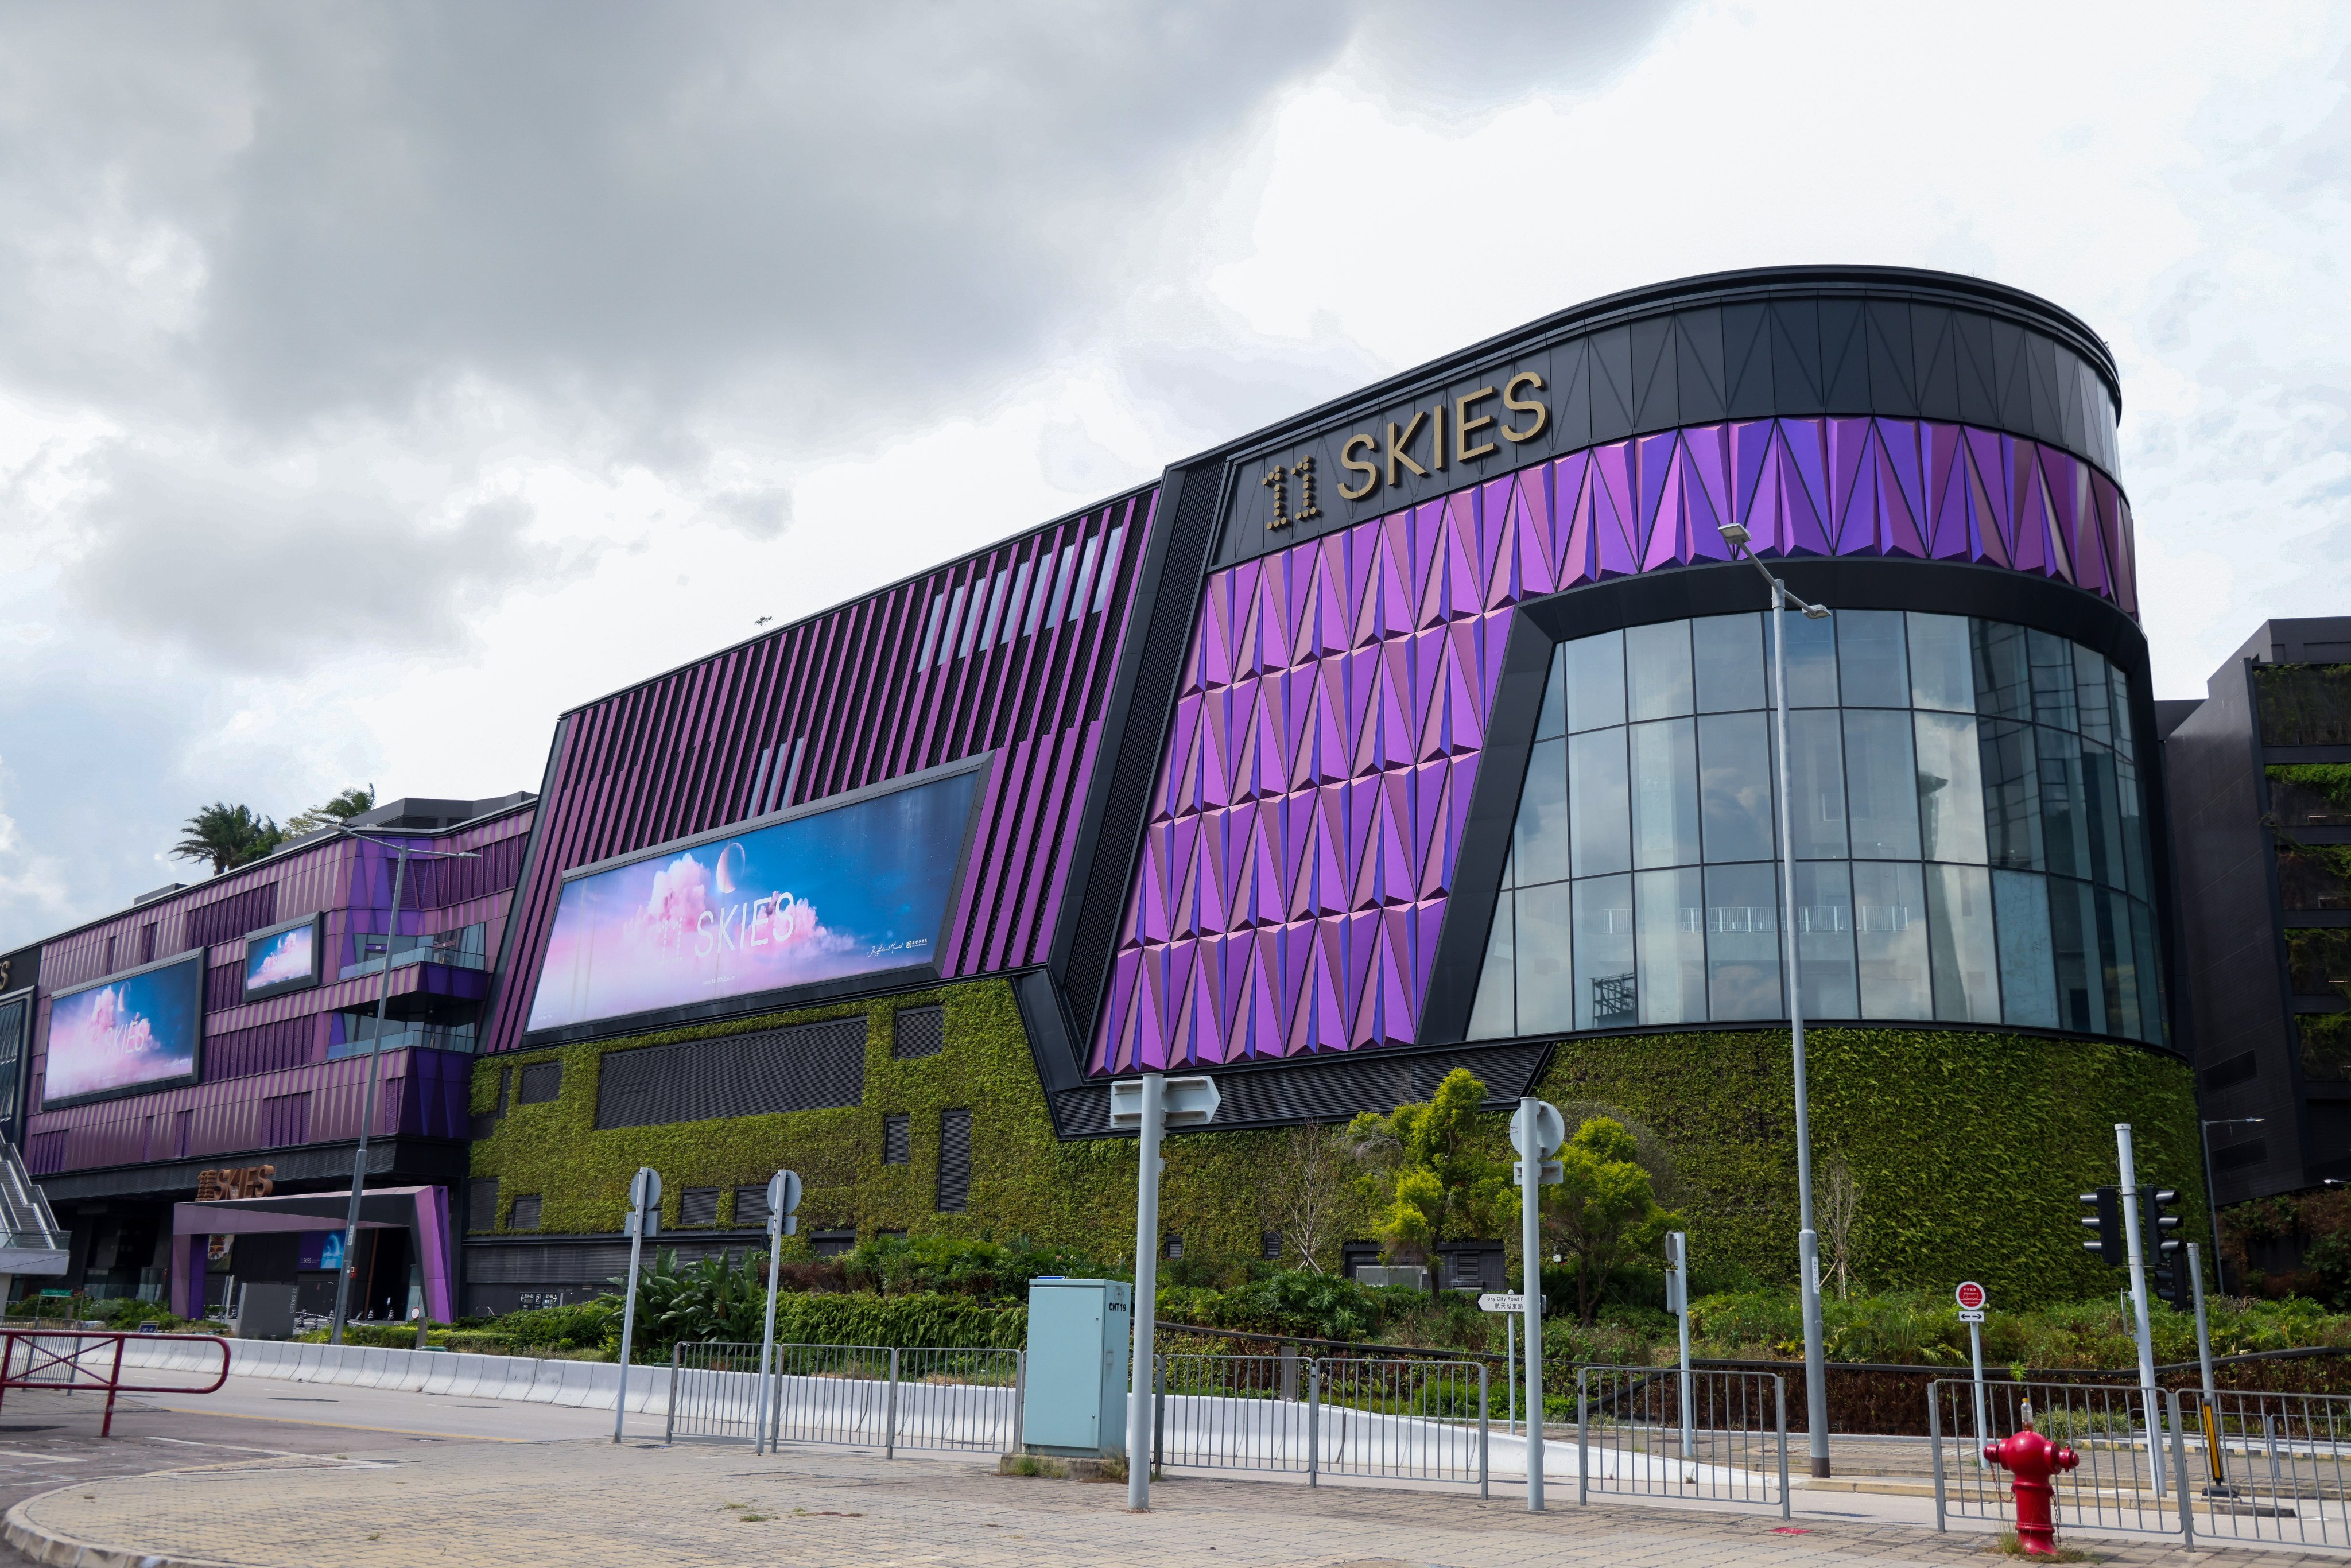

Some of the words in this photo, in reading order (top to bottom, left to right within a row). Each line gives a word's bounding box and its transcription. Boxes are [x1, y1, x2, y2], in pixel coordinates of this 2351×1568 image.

[1262, 455, 1322, 531] 11
[1337, 371, 1550, 500] SKIES
[694, 892, 794, 957] SKIES
[0, 960, 10, 990] S
[104, 1020, 145, 1055] SKIES
[214, 1165, 274, 1201] SKIES
